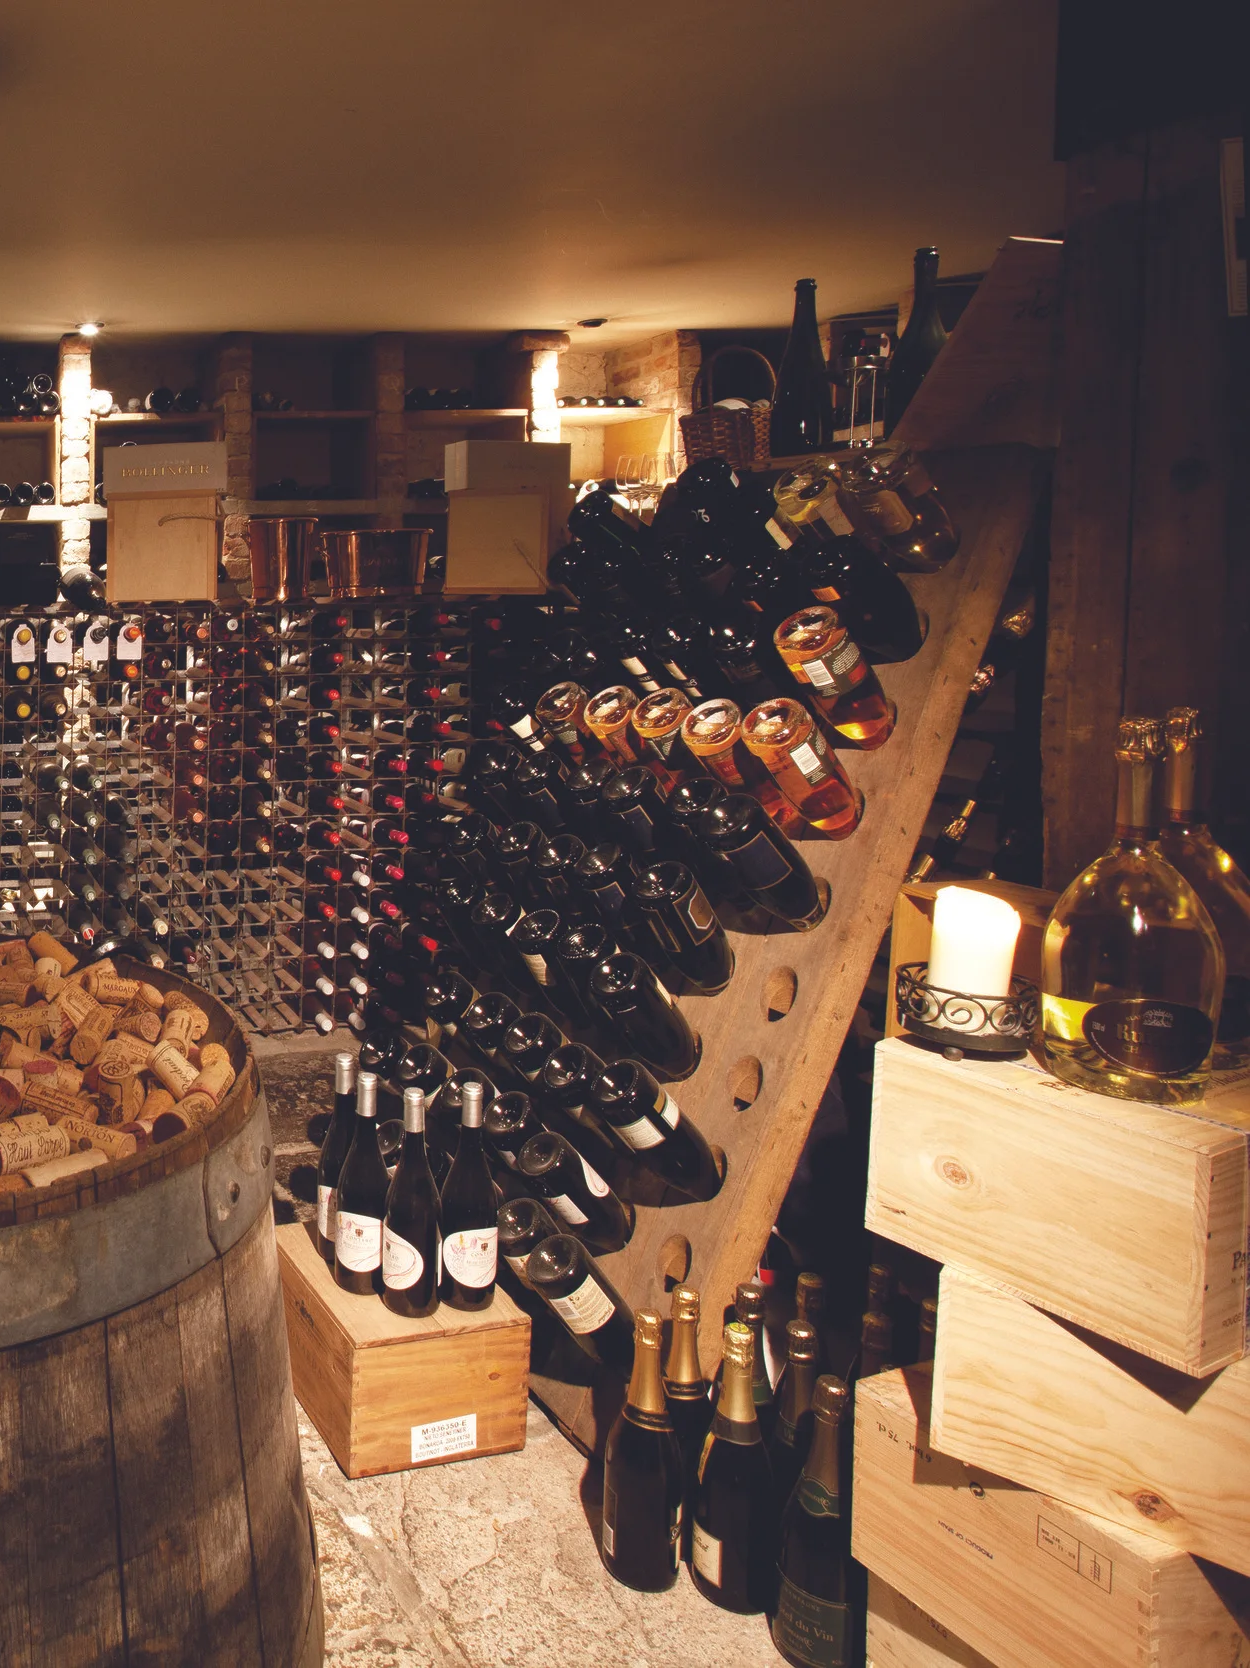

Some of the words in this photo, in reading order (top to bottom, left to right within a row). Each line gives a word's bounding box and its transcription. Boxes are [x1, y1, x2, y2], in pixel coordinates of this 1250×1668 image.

[121, 464, 210, 478] BOLLINGER
[66, 1118, 116, 1144] NORTON
[887, 1429, 899, 1444] 75
[964, 1537, 994, 1560] PRODUCT
[794, 1618, 810, 1633] du
[812, 1625, 835, 1643] Vin
